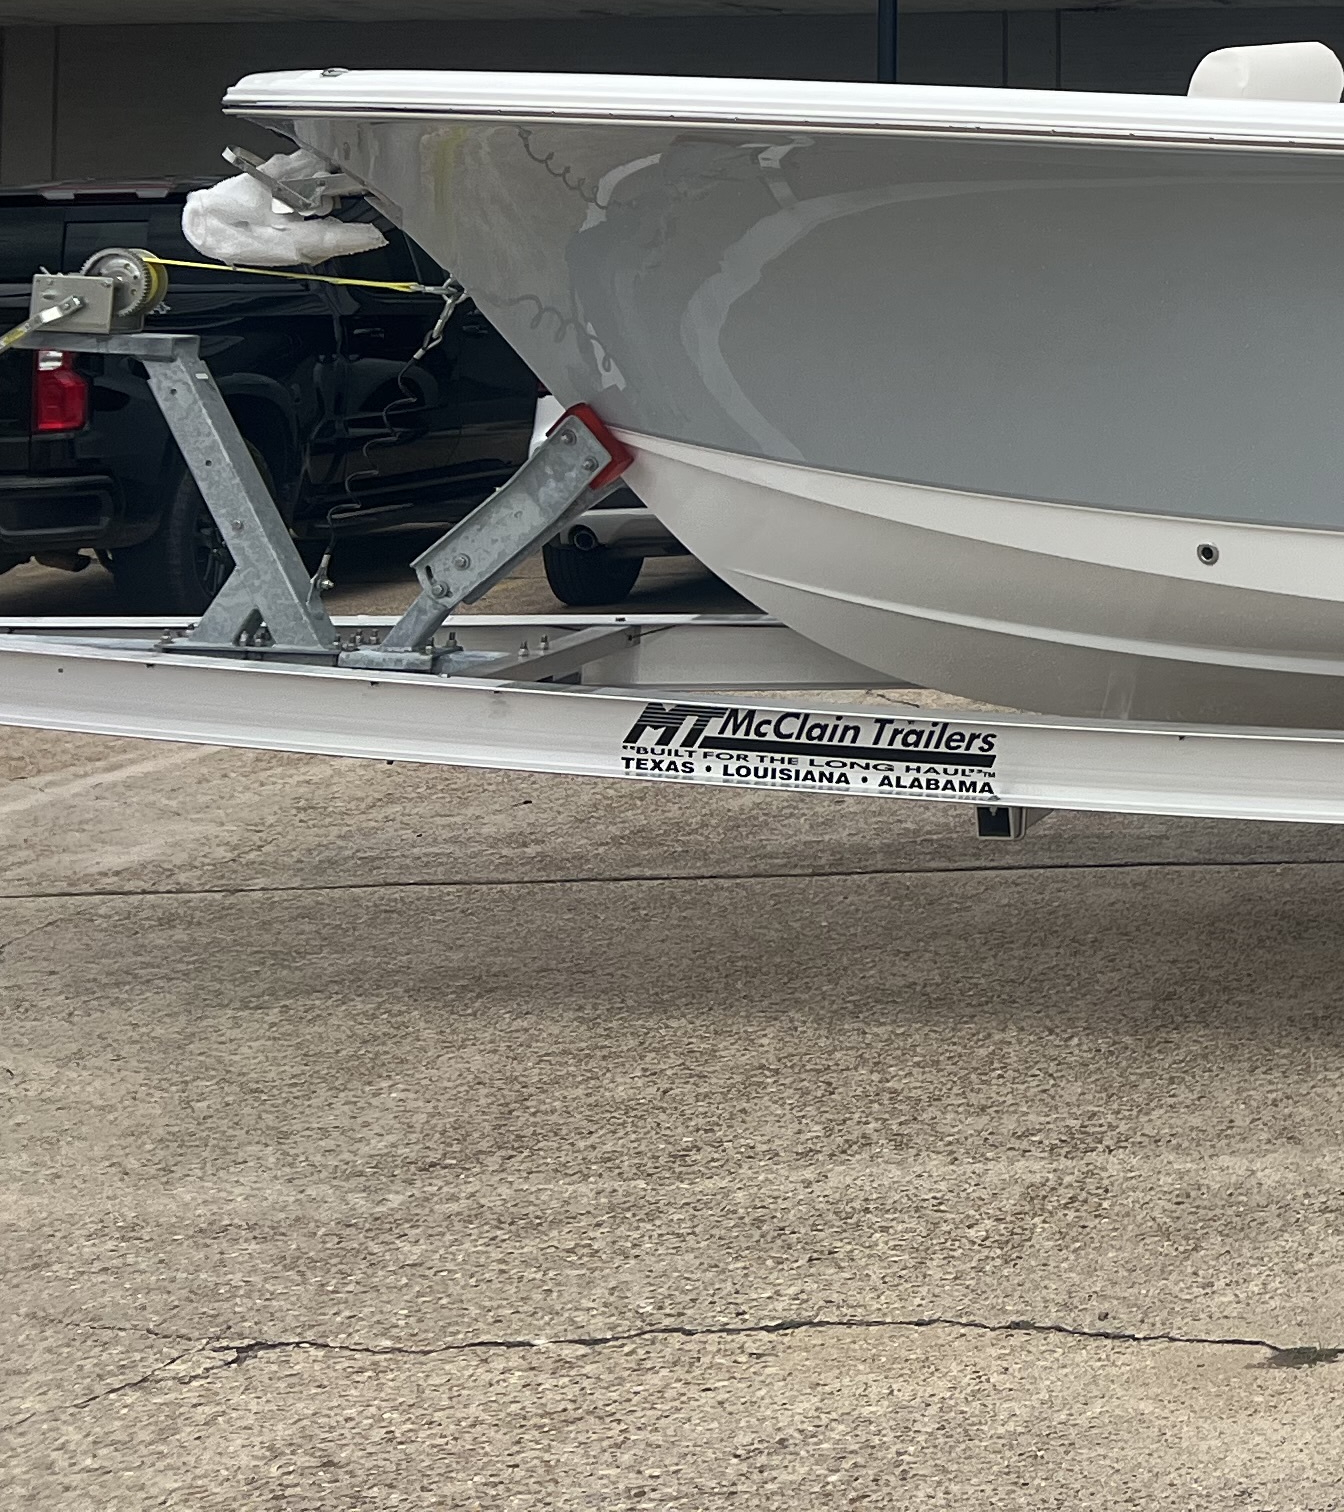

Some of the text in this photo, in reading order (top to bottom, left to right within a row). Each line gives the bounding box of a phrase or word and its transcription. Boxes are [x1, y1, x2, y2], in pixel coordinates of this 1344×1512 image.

[623, 702, 729, 749] MT
[718, 707, 997, 753] McClain Trailers
[621, 757, 995, 795] TEXAS LOUISIANA ALABAMA
[702, 751, 749, 763] FOR
[756, 755, 799, 766] THE
[808, 758, 895, 772] LONG
